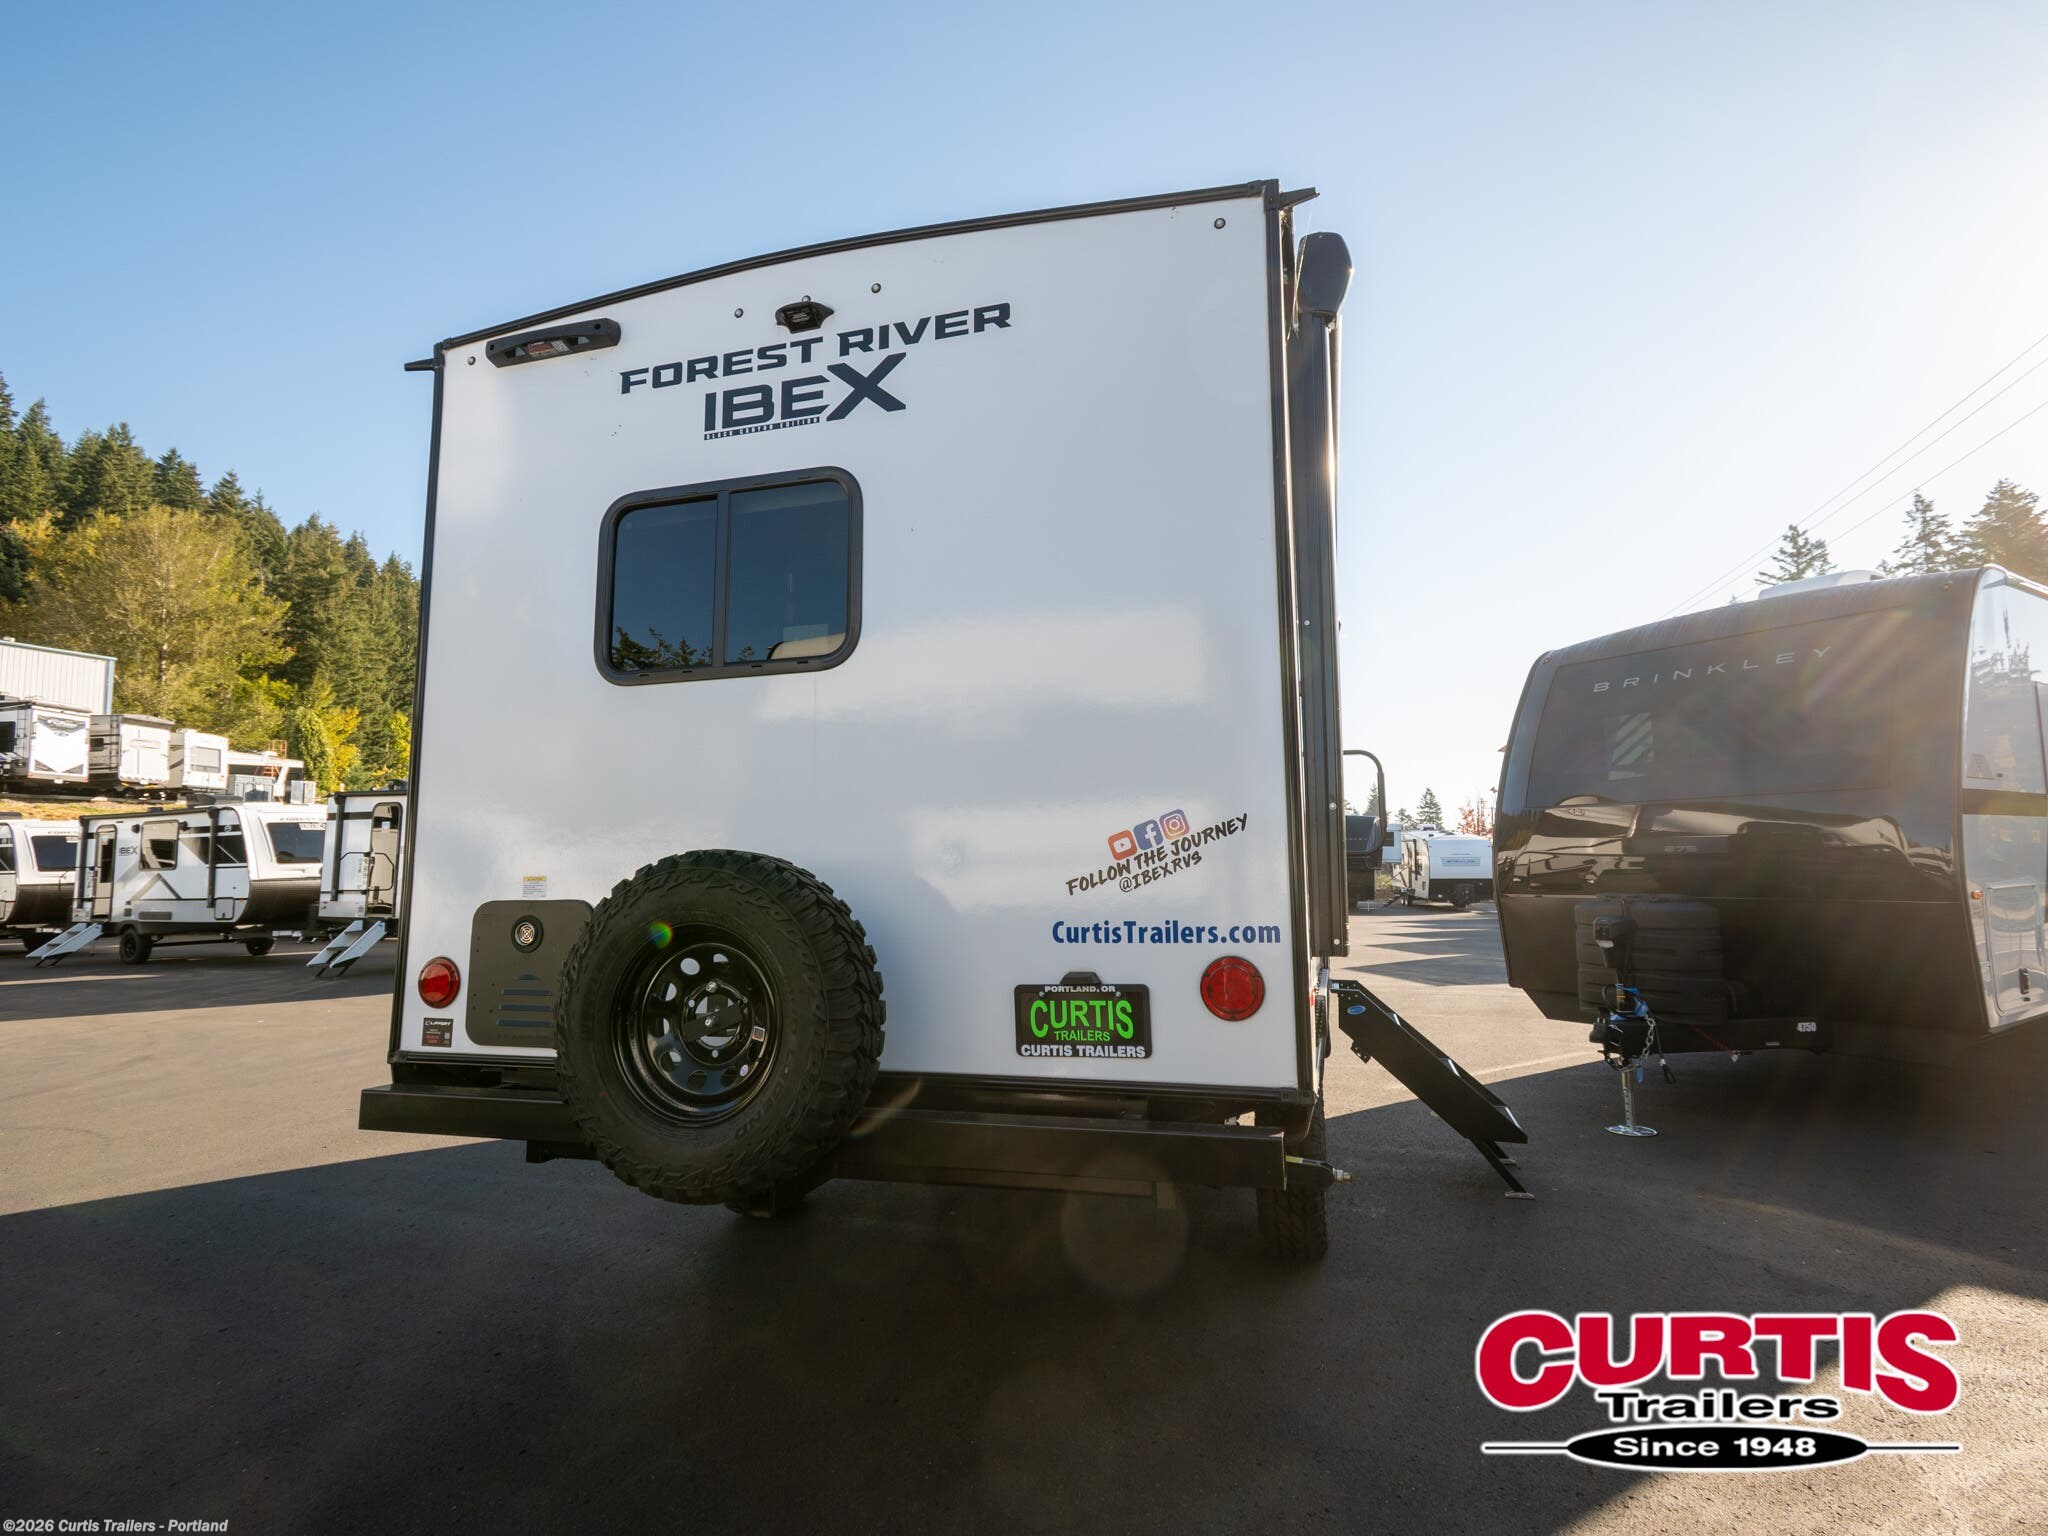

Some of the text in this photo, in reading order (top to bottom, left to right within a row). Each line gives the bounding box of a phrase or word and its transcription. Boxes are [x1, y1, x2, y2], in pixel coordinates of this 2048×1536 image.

[619, 302, 1012, 395] FOREST RIVER
[704, 352, 906, 431] IBEX
[1593, 646, 1831, 693] BRINKLEY
[1066, 813, 1247, 896] FOLLOW THE JOURNEY
[1119, 851, 1202, 893] @IBEXRVS
[1052, 920, 1281, 944] CurtisTrailers.com
[1101, 985, 1116, 993] OR
[1030, 999, 1134, 1039] CURTIS
[1054, 1030, 1111, 1042] TRAILERS
[1021, 1044, 1146, 1058] CURTIS TRAILERS
